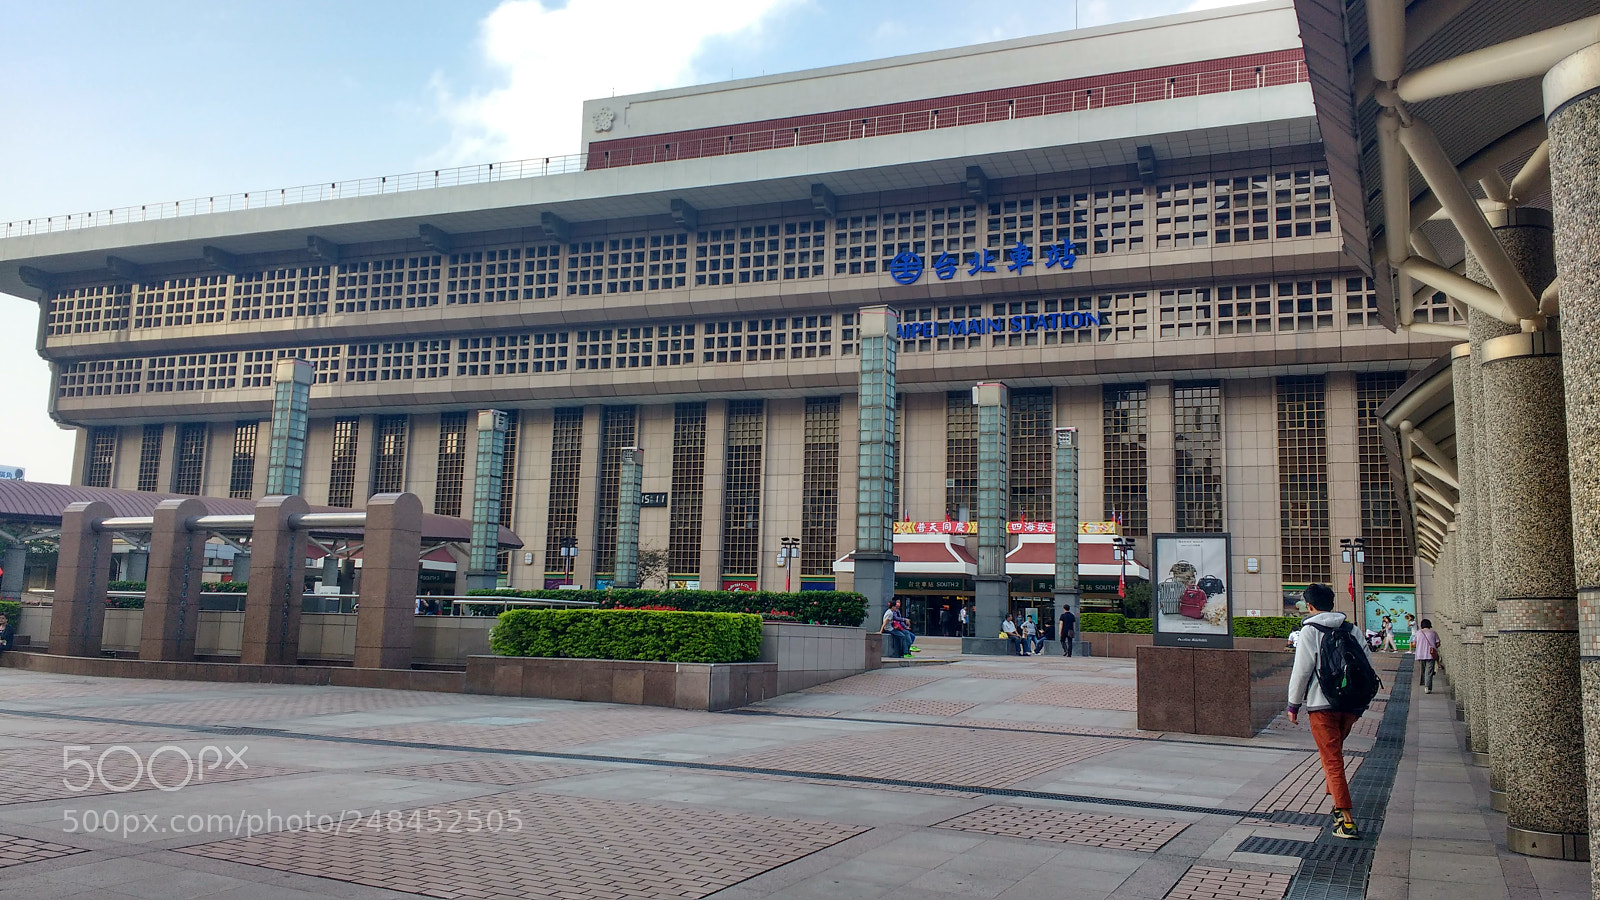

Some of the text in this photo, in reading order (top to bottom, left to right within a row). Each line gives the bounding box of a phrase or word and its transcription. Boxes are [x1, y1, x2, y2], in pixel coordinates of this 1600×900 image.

[933, 238, 1077, 280] 台北車站
[897, 311, 1100, 339] AIPEI MAIN STATION
[641, 494, 665, 504] 15:11
[917, 522, 965, 532] 普天同慶
